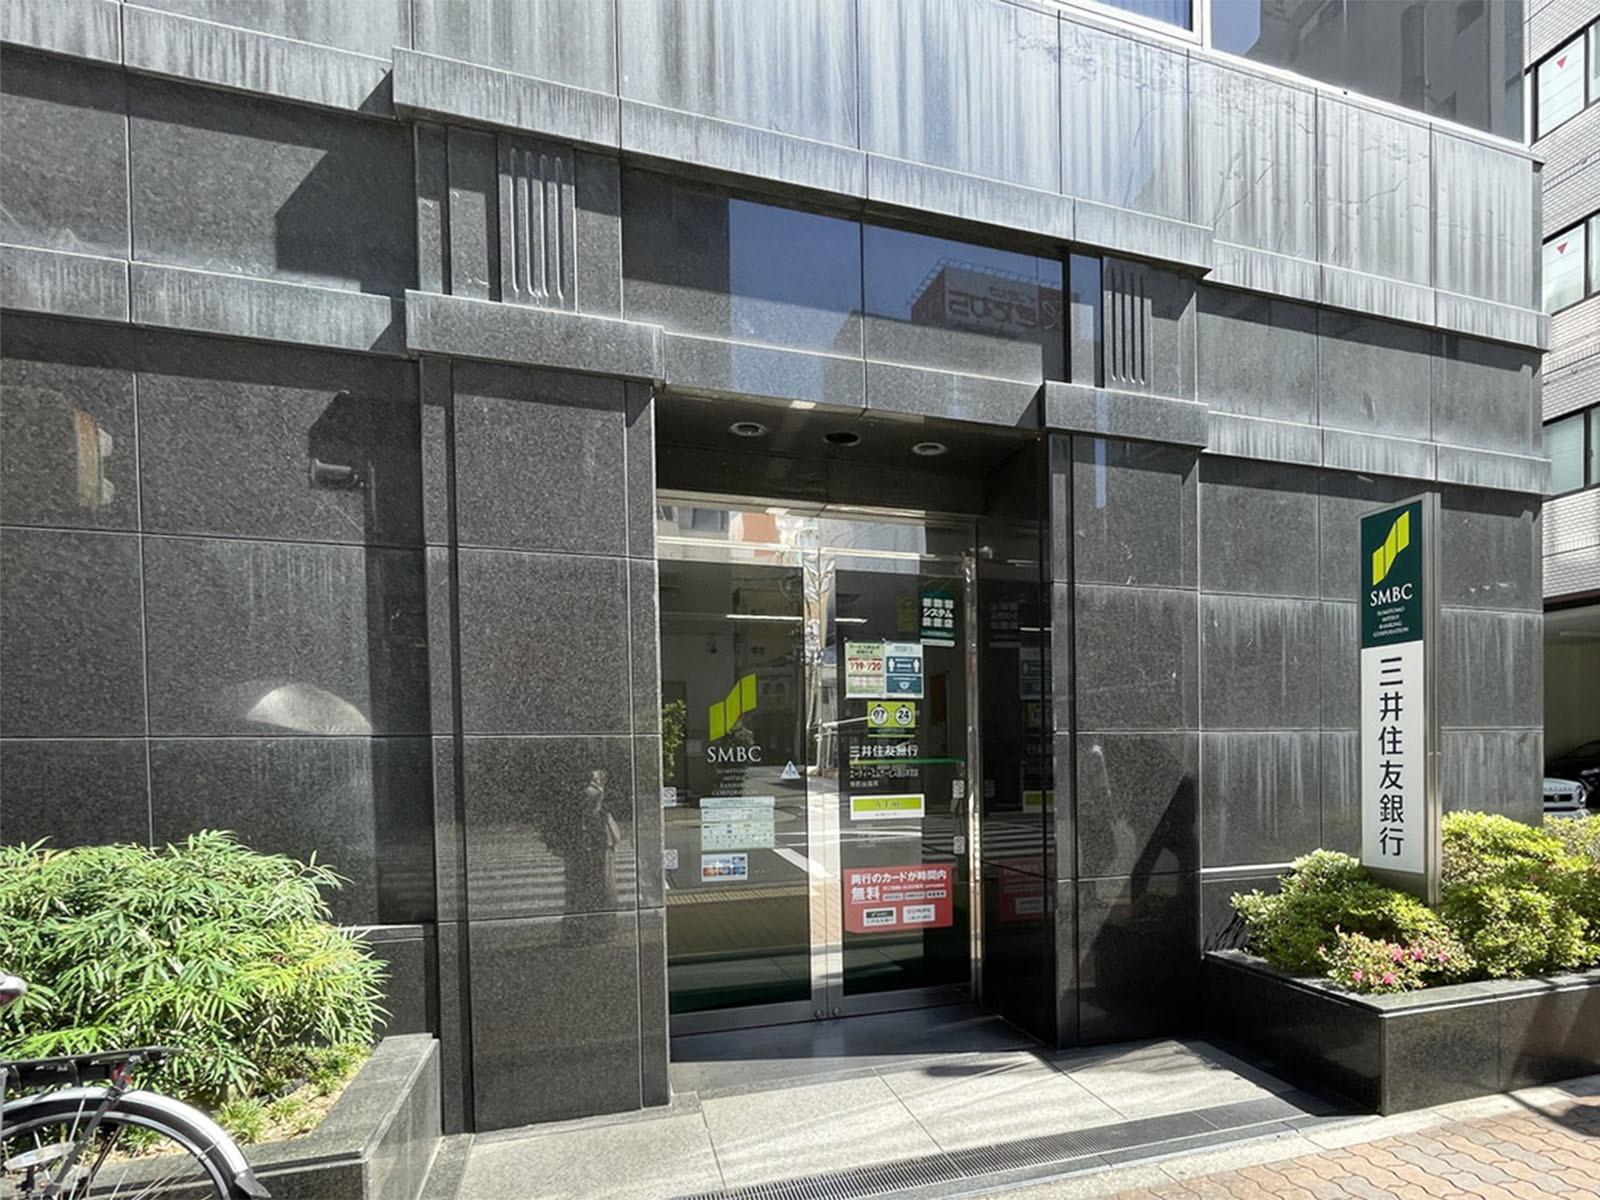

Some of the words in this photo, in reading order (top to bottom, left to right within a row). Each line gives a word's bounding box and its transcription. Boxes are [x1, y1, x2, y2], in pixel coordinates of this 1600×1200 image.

[1370, 583, 1413, 607] SMBC
[923, 608, 954, 618] システム
[898, 710, 910, 719] 24
[707, 745, 762, 763] SMBC
[1378, 656, 1404, 857] 三井住友銀行
[851, 886, 880, 901] 無料
